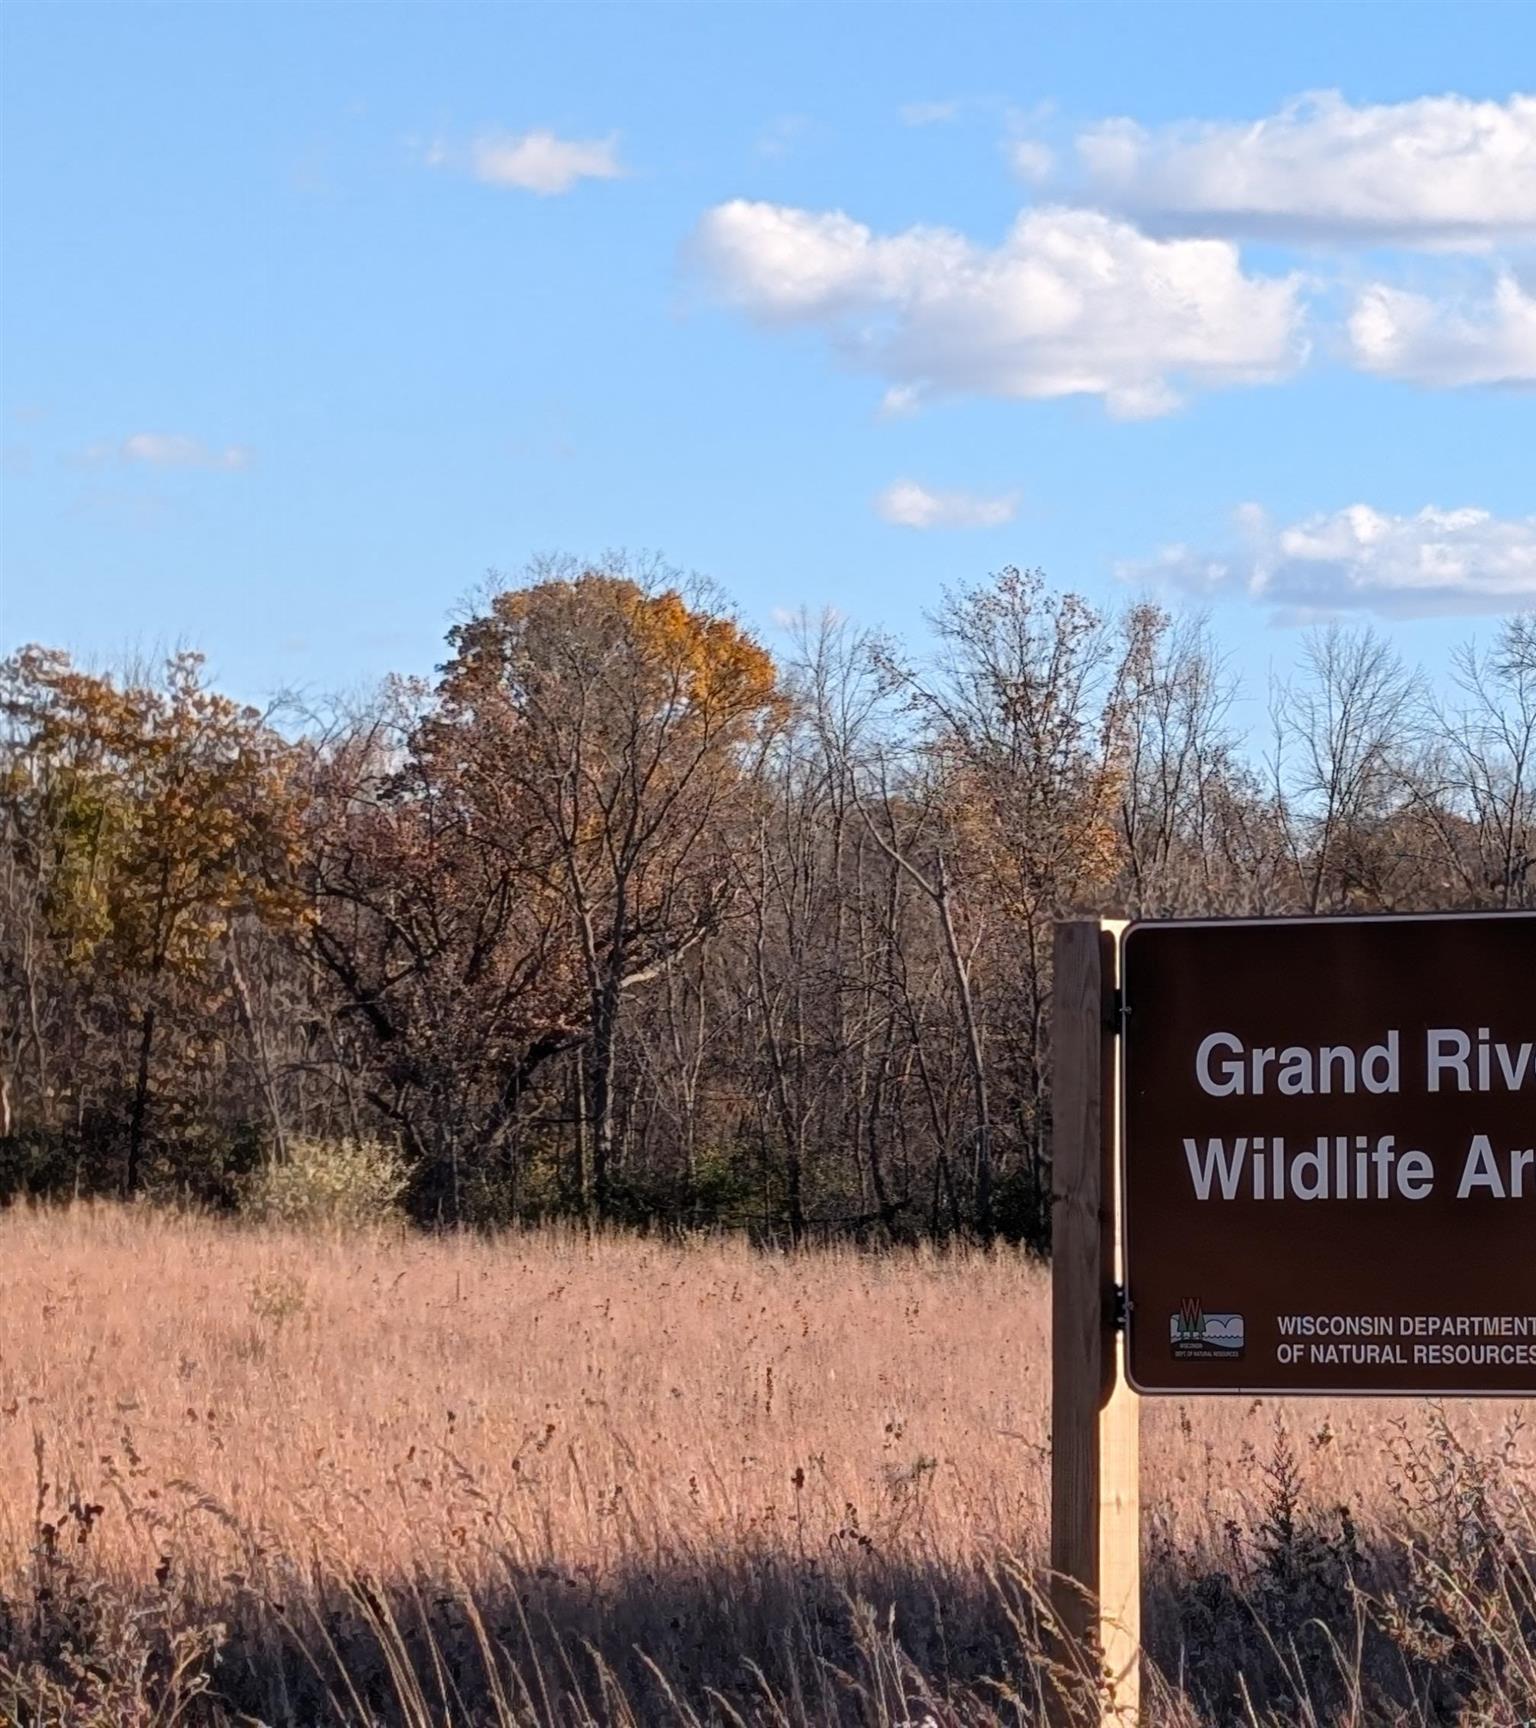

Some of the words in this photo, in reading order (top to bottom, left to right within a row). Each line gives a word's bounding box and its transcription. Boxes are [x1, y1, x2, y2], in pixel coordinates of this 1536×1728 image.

[1195, 1030, 1401, 1097] Grand
[1183, 1135, 1434, 1200] Wildlife
[1277, 1316, 1393, 1336] WISCONSIN
[1277, 1344, 1304, 1364] OF
[1311, 1344, 1407, 1364] NATURAL
